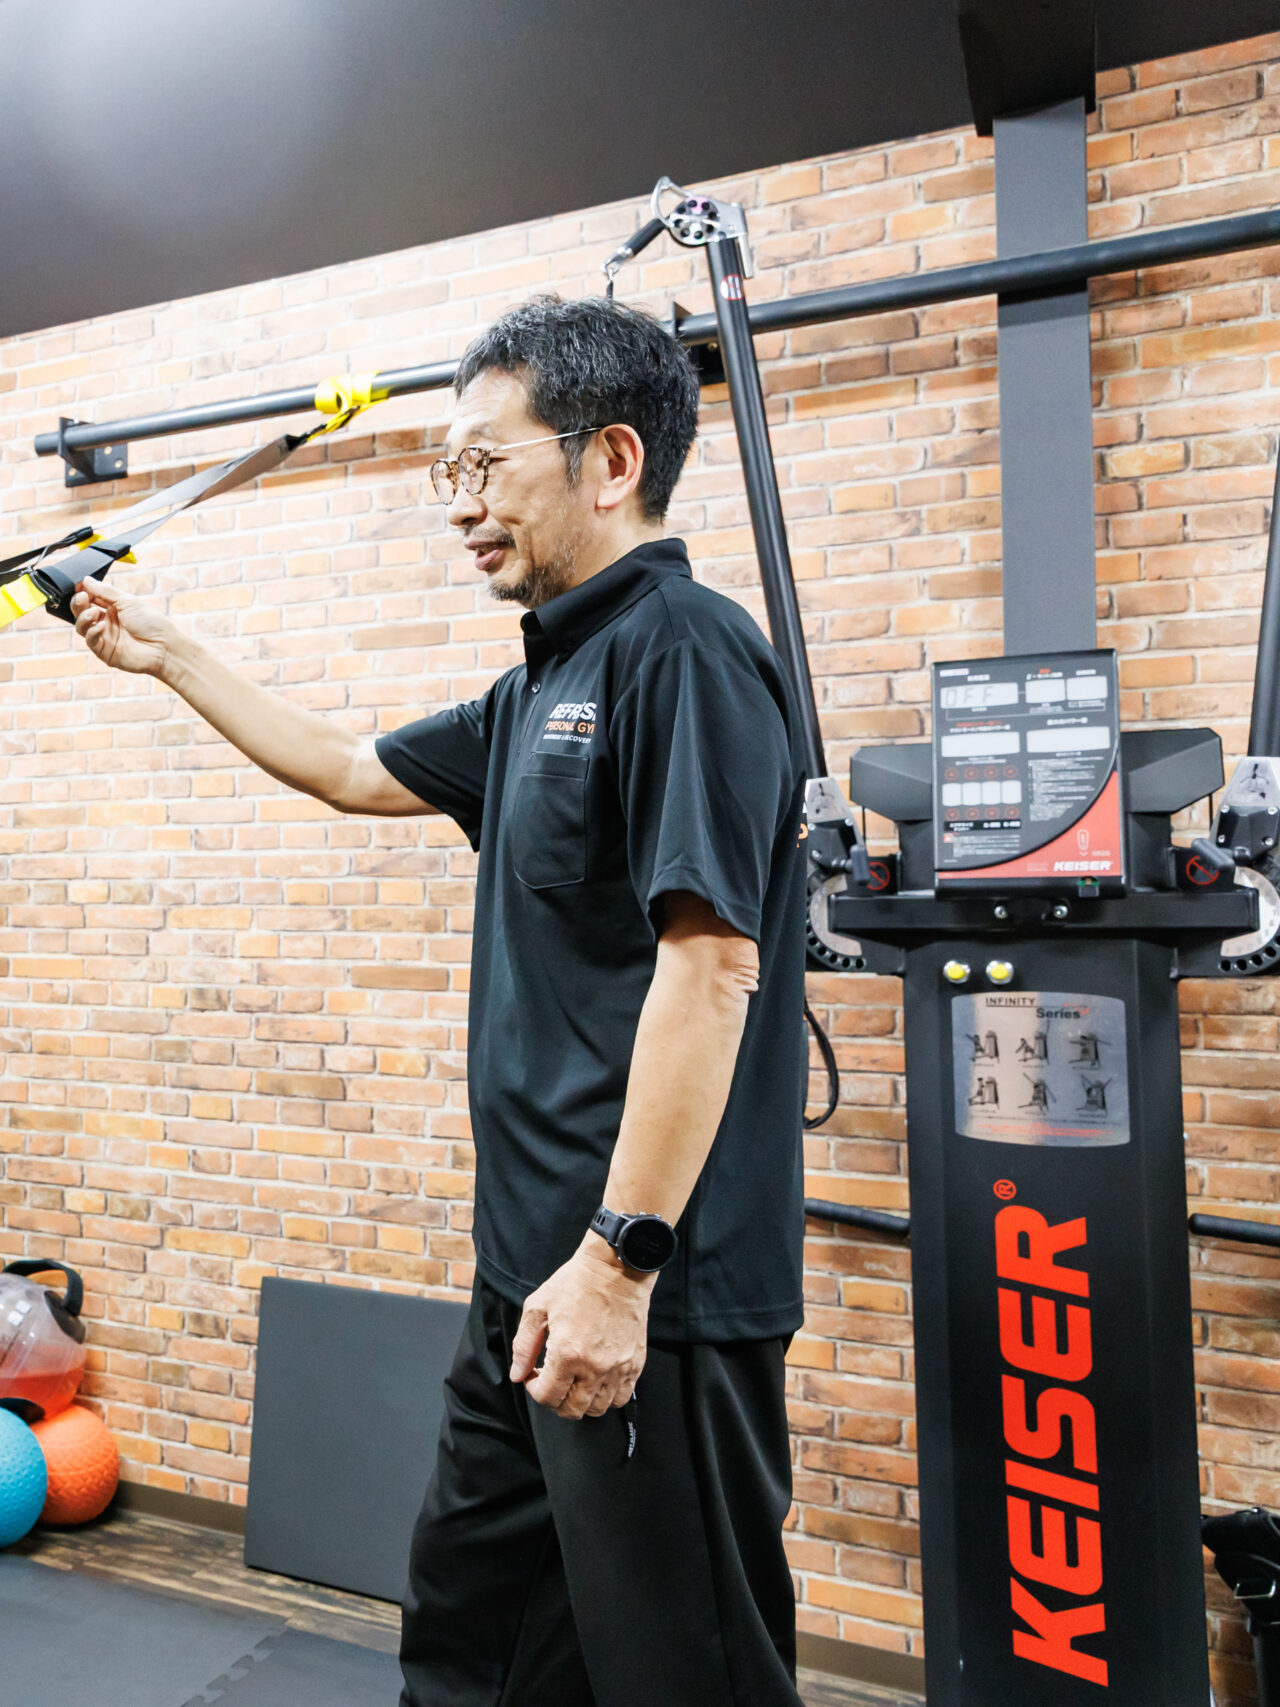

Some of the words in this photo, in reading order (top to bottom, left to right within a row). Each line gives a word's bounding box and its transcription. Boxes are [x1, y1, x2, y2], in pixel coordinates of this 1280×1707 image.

[1053, 860, 1112, 872] KEISER
[985, 997, 1035, 1005] INFINITY
[1036, 1007, 1081, 1019] Series
